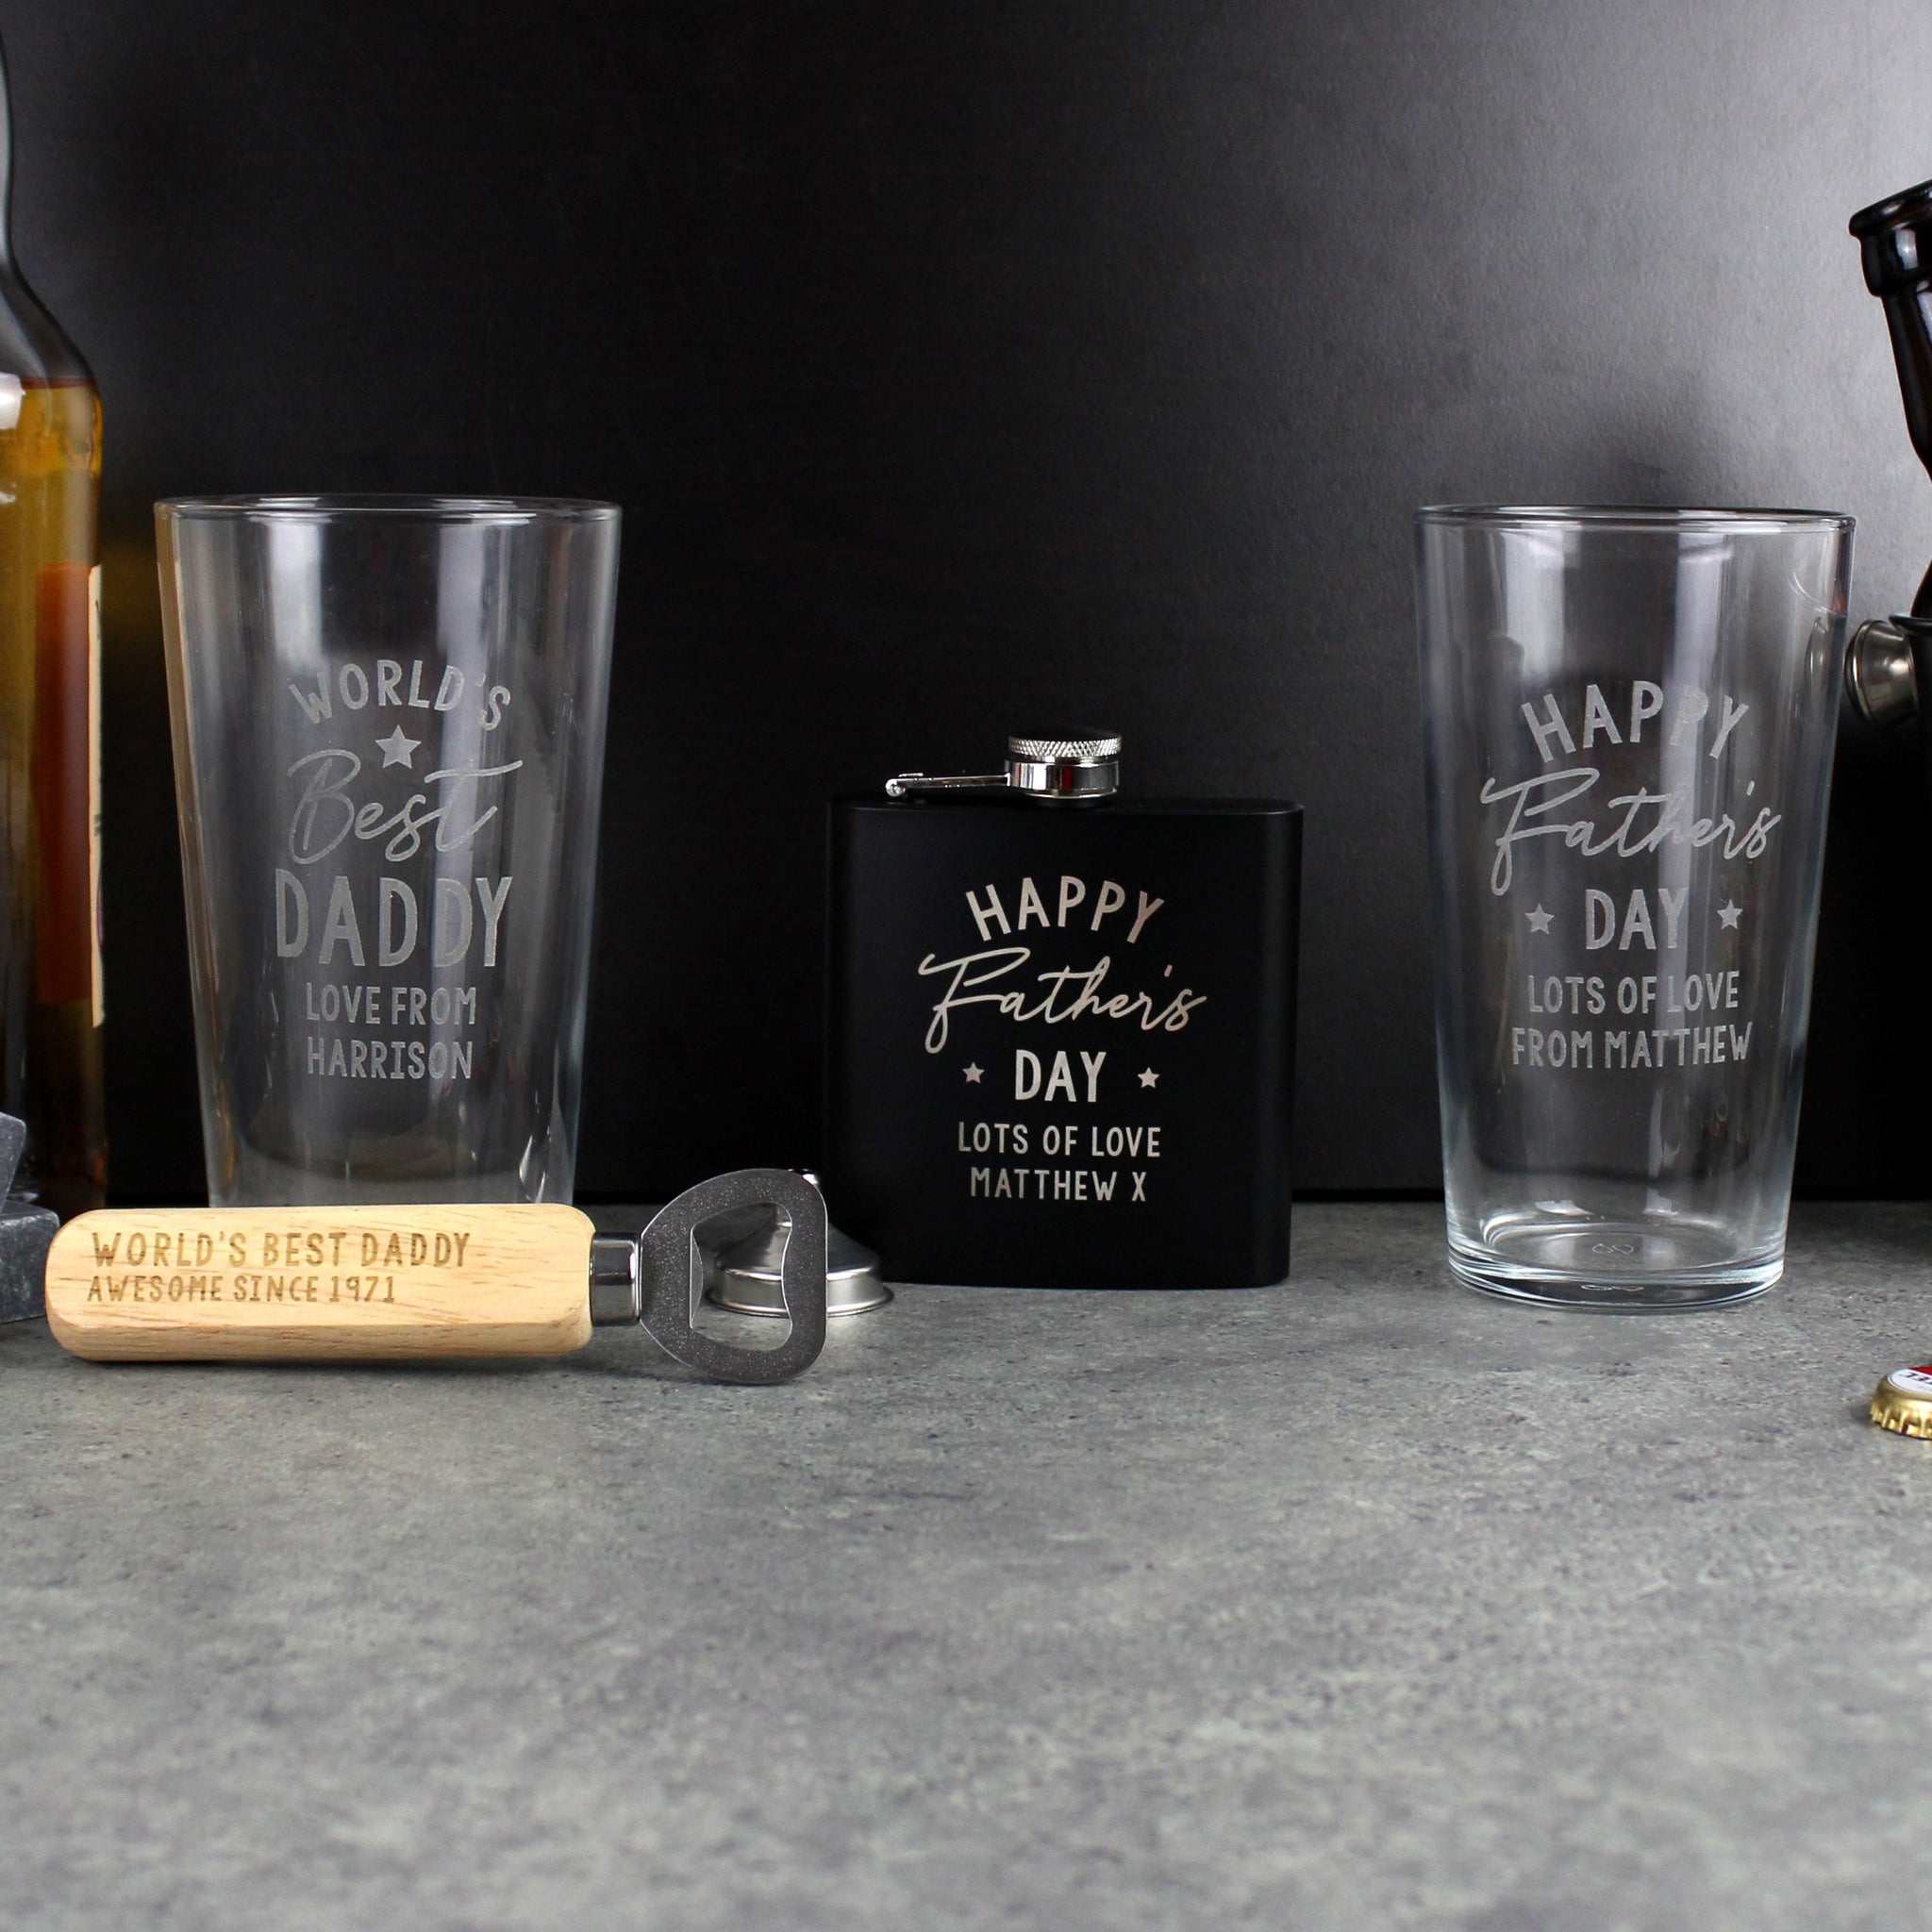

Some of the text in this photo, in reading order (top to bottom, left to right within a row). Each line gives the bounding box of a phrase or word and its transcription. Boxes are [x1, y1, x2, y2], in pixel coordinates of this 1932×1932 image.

[288, 659, 511, 731] WORLD'S
[1522, 680, 1749, 762] HAPPY
[287, 749, 523, 864] Best
[1480, 768, 1781, 895] Father's
[275, 868, 513, 967] DADDY
[965, 875, 1165, 943] HAPPY
[1585, 889, 1688, 950] DAY
[306, 982, 477, 1025] LOVE FROM
[918, 947, 1208, 1054] Father's
[1527, 971, 1740, 1014] LOTS OF LOVE
[307, 1036, 473, 1080] HARRISON
[1512, 1022, 1753, 1069] FROM MATTHEW
[1015, 1049, 1107, 1103] DAY
[958, 1121, 1161, 1158] LOTS OF LOVE
[970, 1166, 1147, 1203] MATTHEW X
[92, 1232, 470, 1269] WORLD'S BEST DADDY
[87, 1275, 395, 1304] AWESOME SINCE 1971
